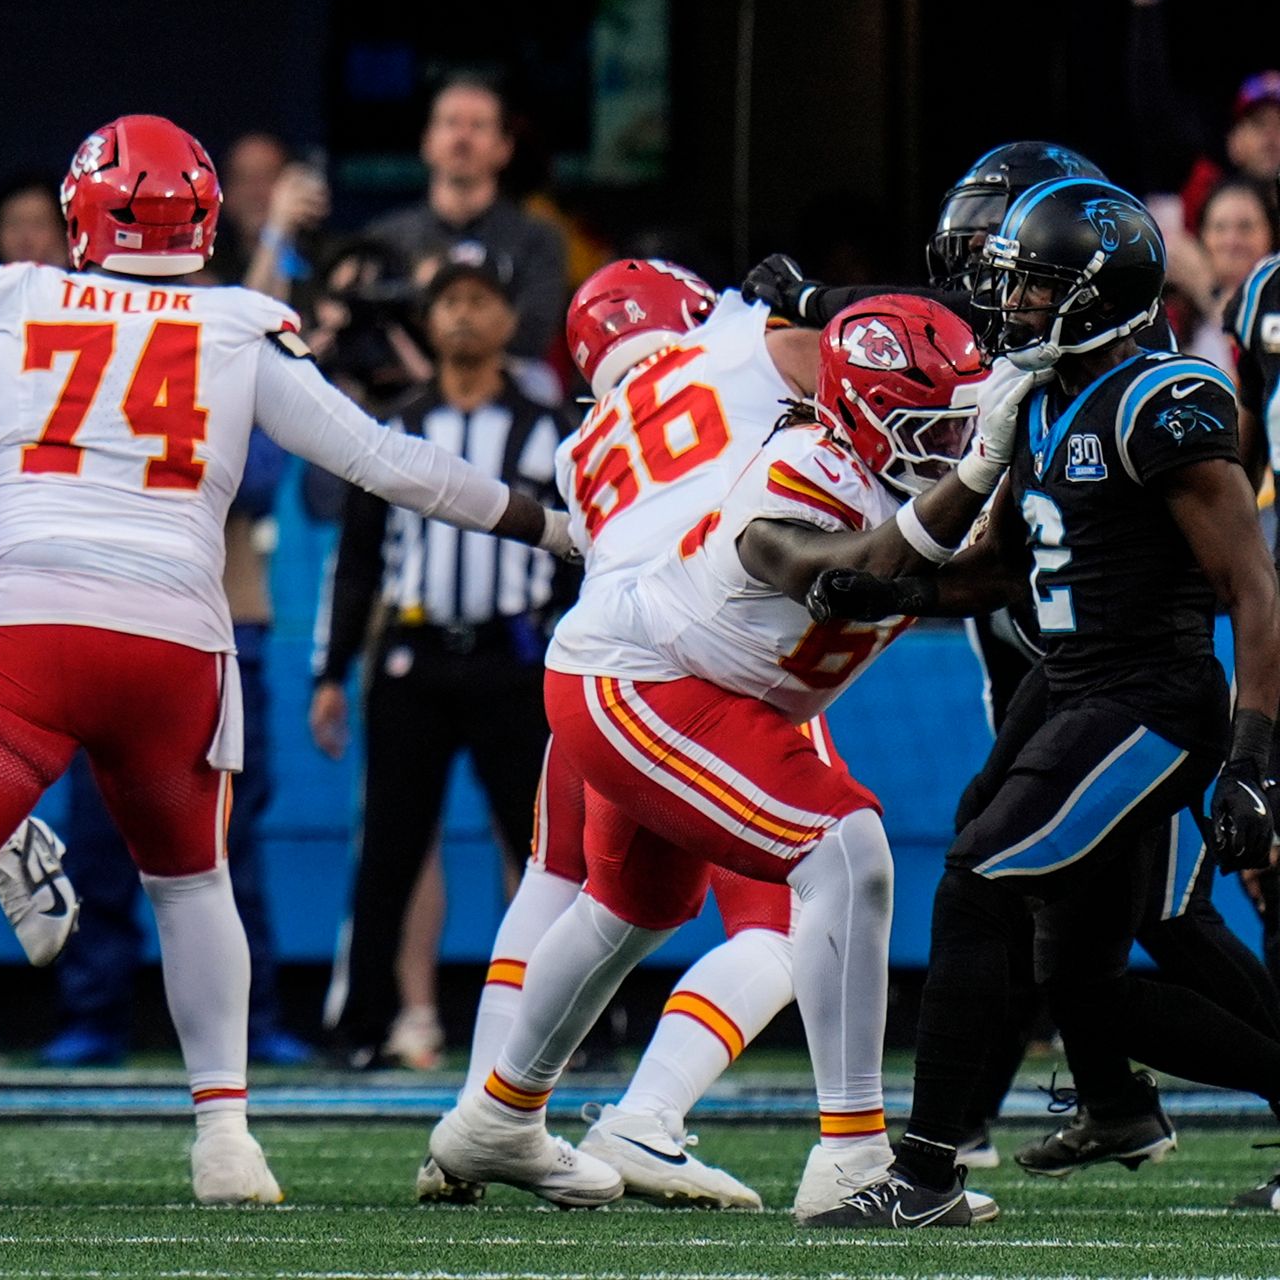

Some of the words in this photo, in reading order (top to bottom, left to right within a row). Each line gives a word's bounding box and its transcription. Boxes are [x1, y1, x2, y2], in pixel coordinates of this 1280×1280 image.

[60, 279, 193, 315] TAYLOR
[18, 317, 211, 492] 74
[570, 344, 734, 544] 56
[1070, 437, 1099, 466] 30
